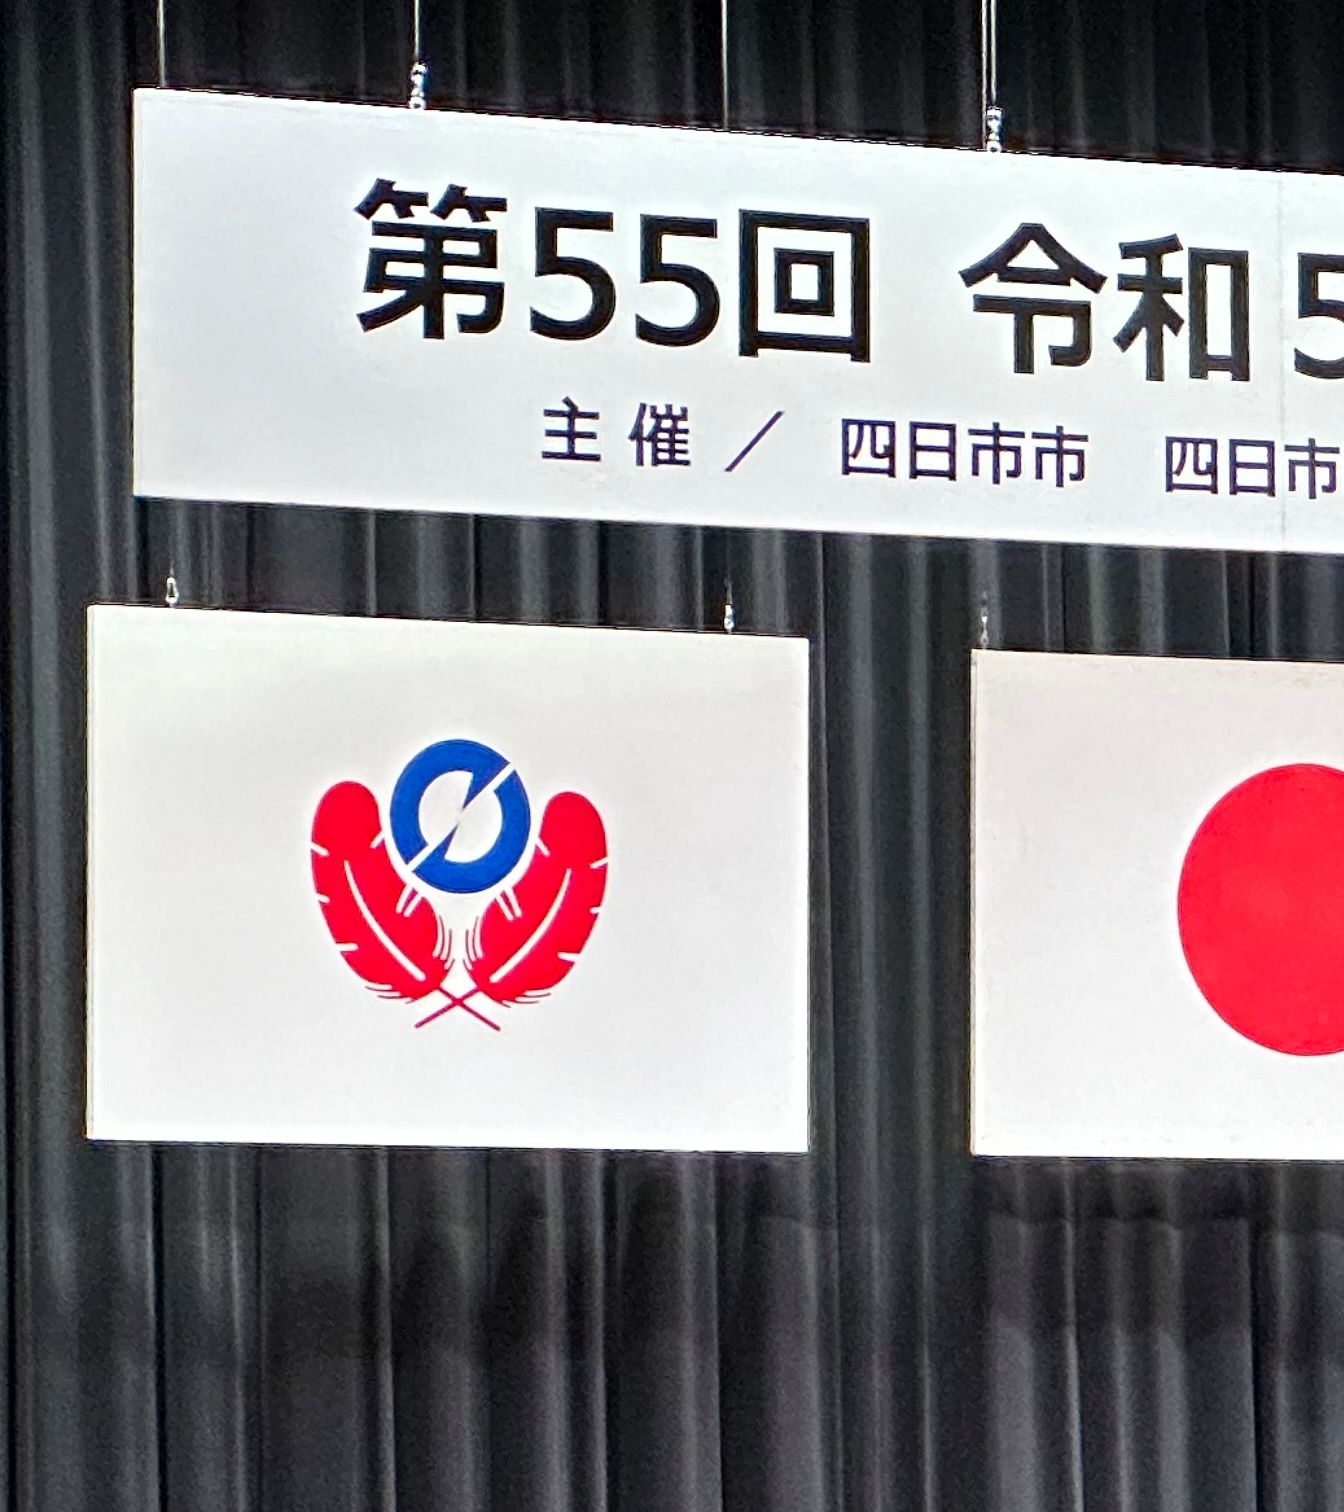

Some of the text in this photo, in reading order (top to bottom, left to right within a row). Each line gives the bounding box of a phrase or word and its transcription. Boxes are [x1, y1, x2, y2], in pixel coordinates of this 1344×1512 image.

[354, 178, 870, 363] 第55回
[842, 419, 1088, 487] 四日市市
